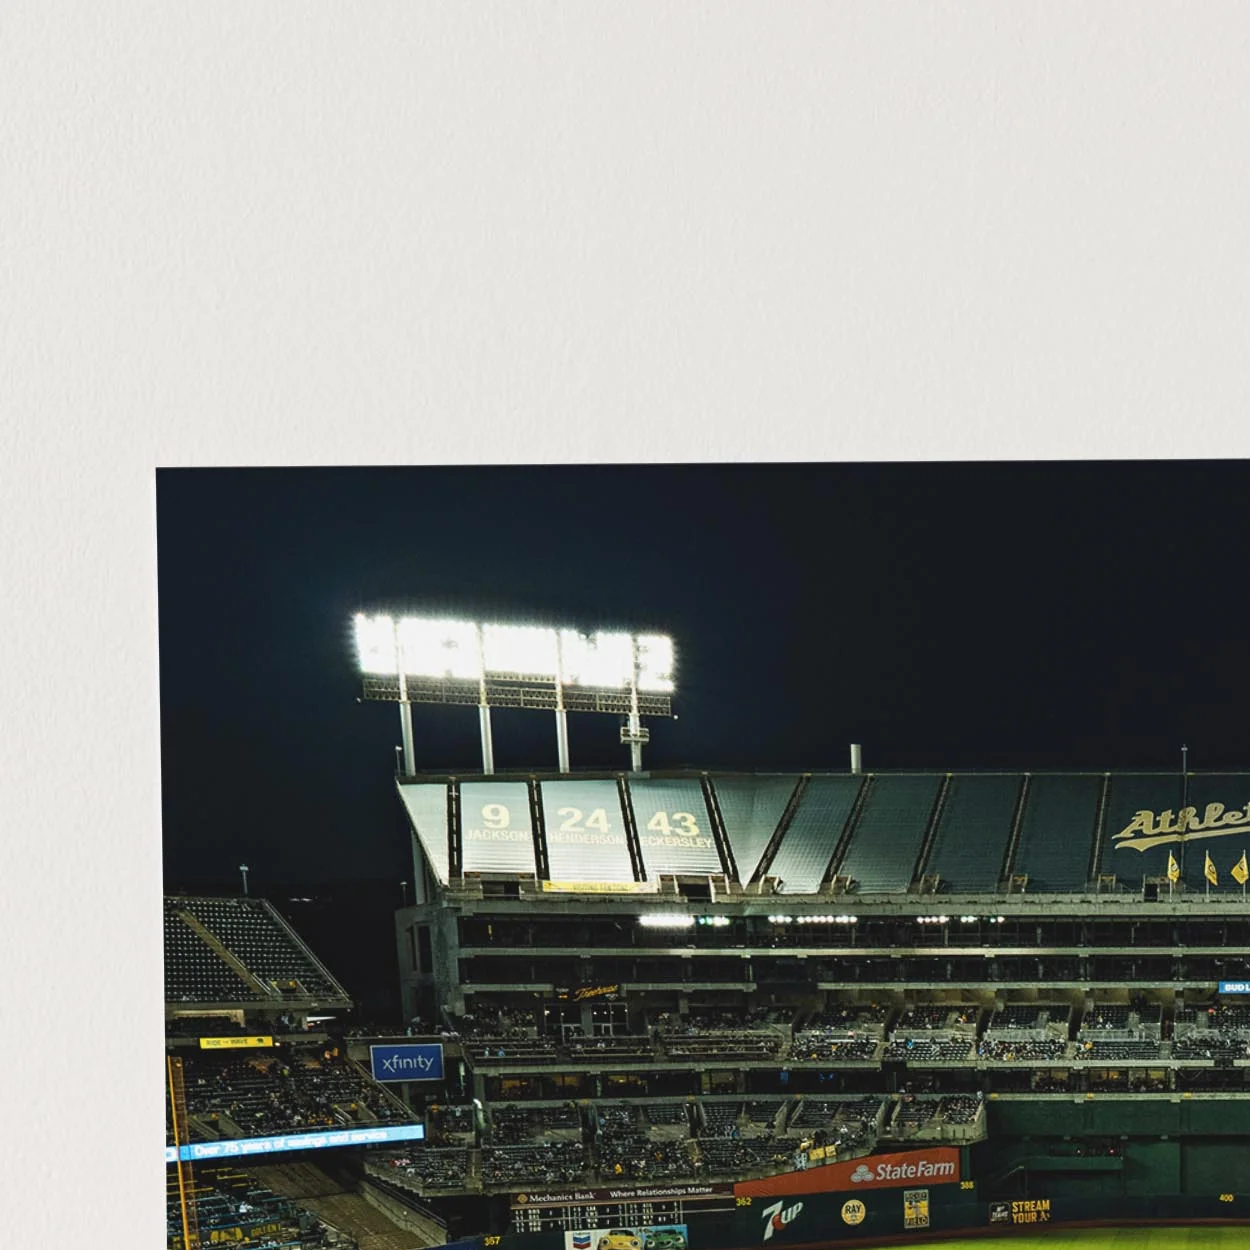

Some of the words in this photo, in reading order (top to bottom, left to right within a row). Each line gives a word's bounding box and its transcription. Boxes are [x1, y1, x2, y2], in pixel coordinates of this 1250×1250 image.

[482, 804, 511, 829] 9
[557, 807, 612, 832] 24
[647, 811, 700, 837] 43
[465, 829, 532, 842] JACKSON
[642, 836, 714, 849] ECKERSLEY
[1225, 983, 1245, 992] BUD
[382, 1055, 434, 1073] xfinity
[529, 1193, 574, 1202] Mechanics
[575, 1191, 596, 1201] Bank
[610, 1190, 635, 1199] Where
[636, 1187, 687, 1198] Relationships
[688, 1186, 713, 1195] Matter
[1219, 1193, 1234, 1202] 400
[1011, 1199, 1050, 1213] STREAM
[1012, 1212, 1037, 1224] YOUR
